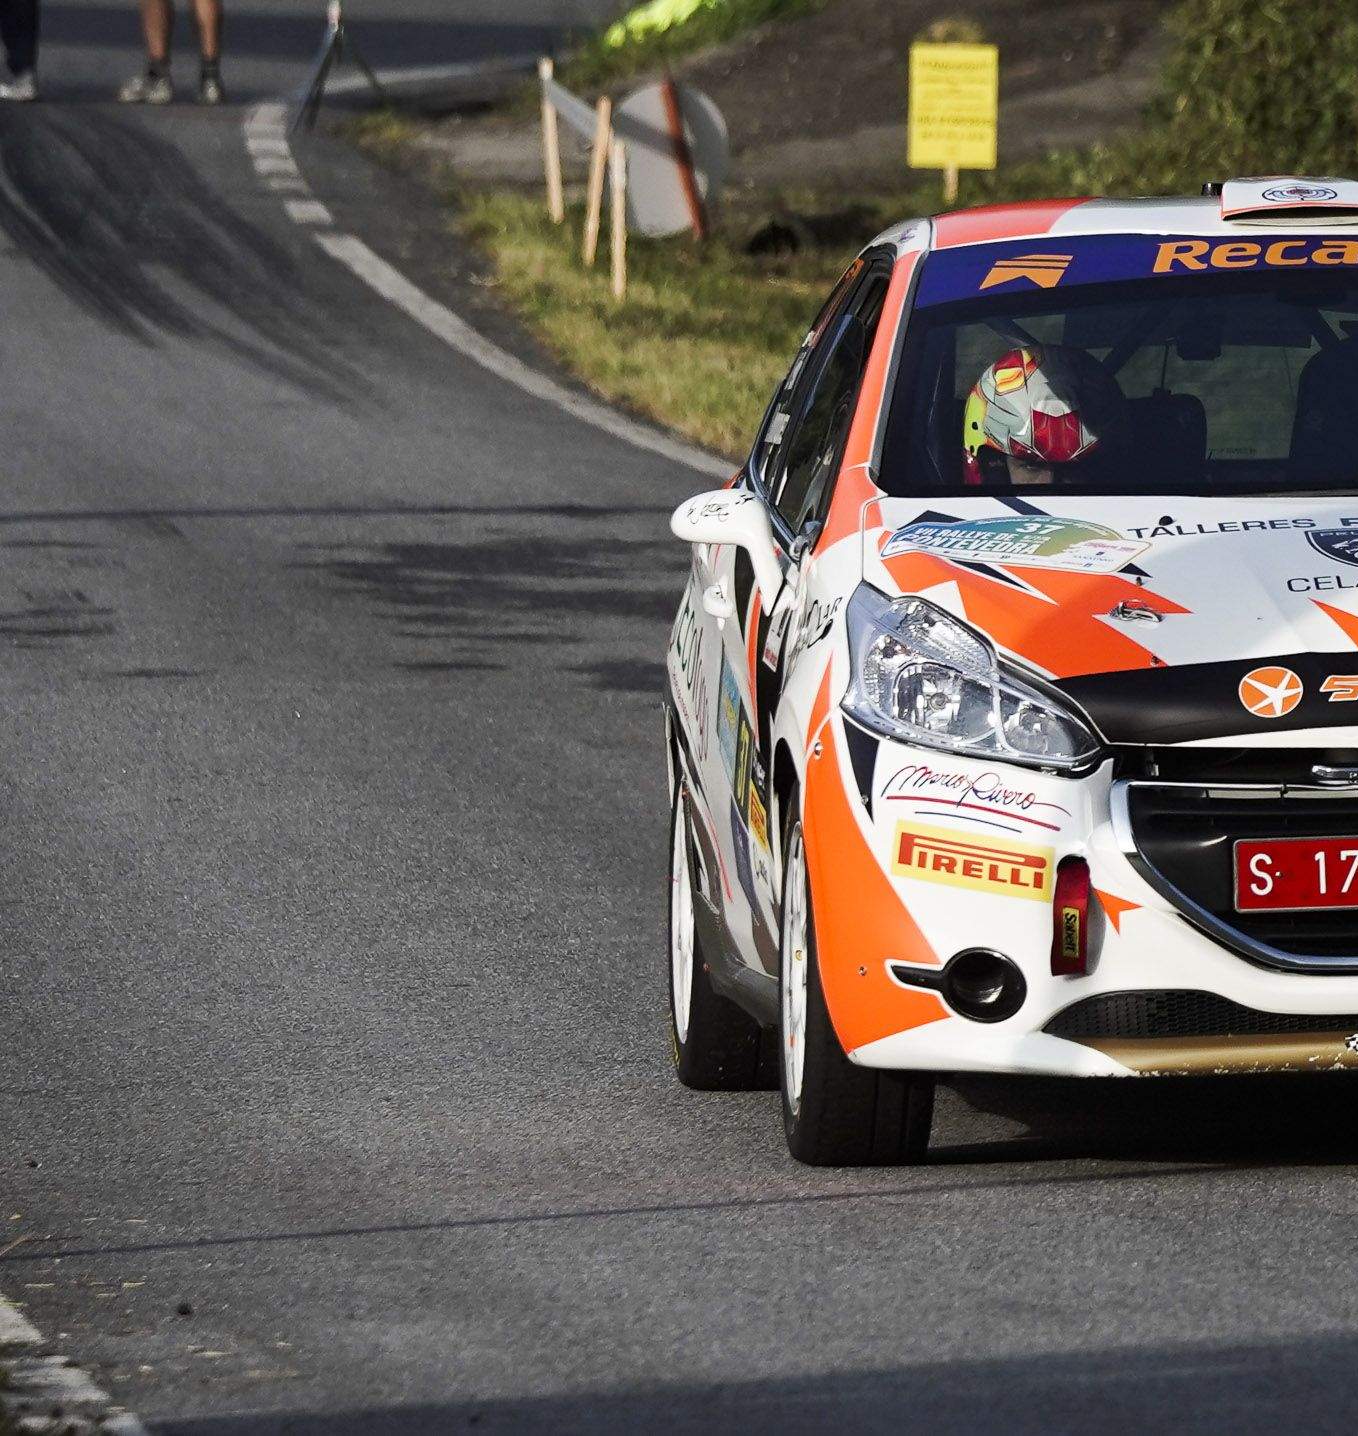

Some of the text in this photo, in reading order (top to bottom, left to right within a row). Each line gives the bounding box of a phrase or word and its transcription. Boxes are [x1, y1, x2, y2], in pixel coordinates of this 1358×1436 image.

[936, 529, 996, 540] RALLYE
[993, 532, 1019, 541] DE
[1127, 518, 1317, 539] TALLERES
[901, 534, 1042, 555] PONTEVEDRA
[898, 832, 1048, 890] PIRELLI
[1249, 853, 1274, 896] S
